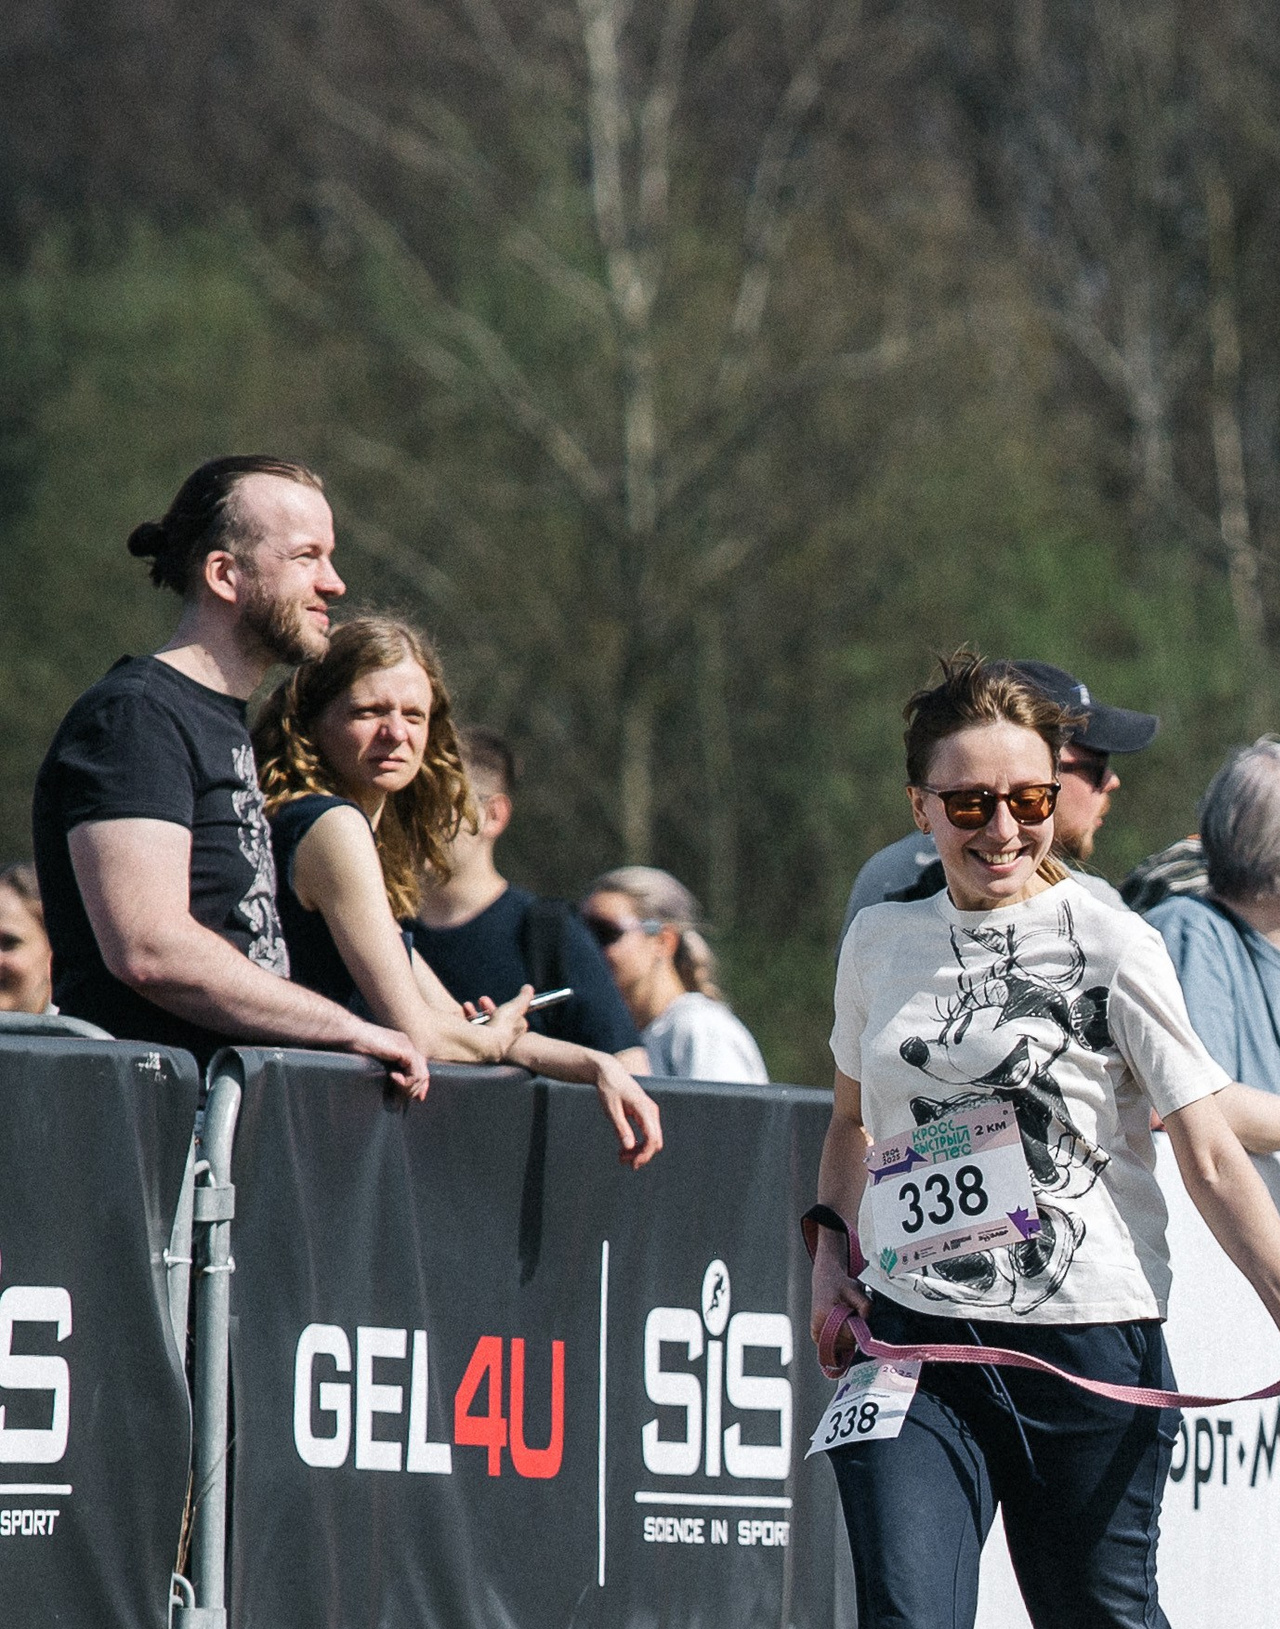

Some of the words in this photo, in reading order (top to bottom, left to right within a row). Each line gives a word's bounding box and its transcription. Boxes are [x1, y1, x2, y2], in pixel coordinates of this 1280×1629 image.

[913, 1126, 971, 1155] БЫСТРЫЙ
[974, 1125, 984, 1136] 2
[898, 1164, 988, 1233] 338
[293, 1322, 565, 1479] GEL4U
[825, 1402, 879, 1444] 338
[0, 1509, 60, 1535] SPORT
[711, 1519, 728, 1545] IN
